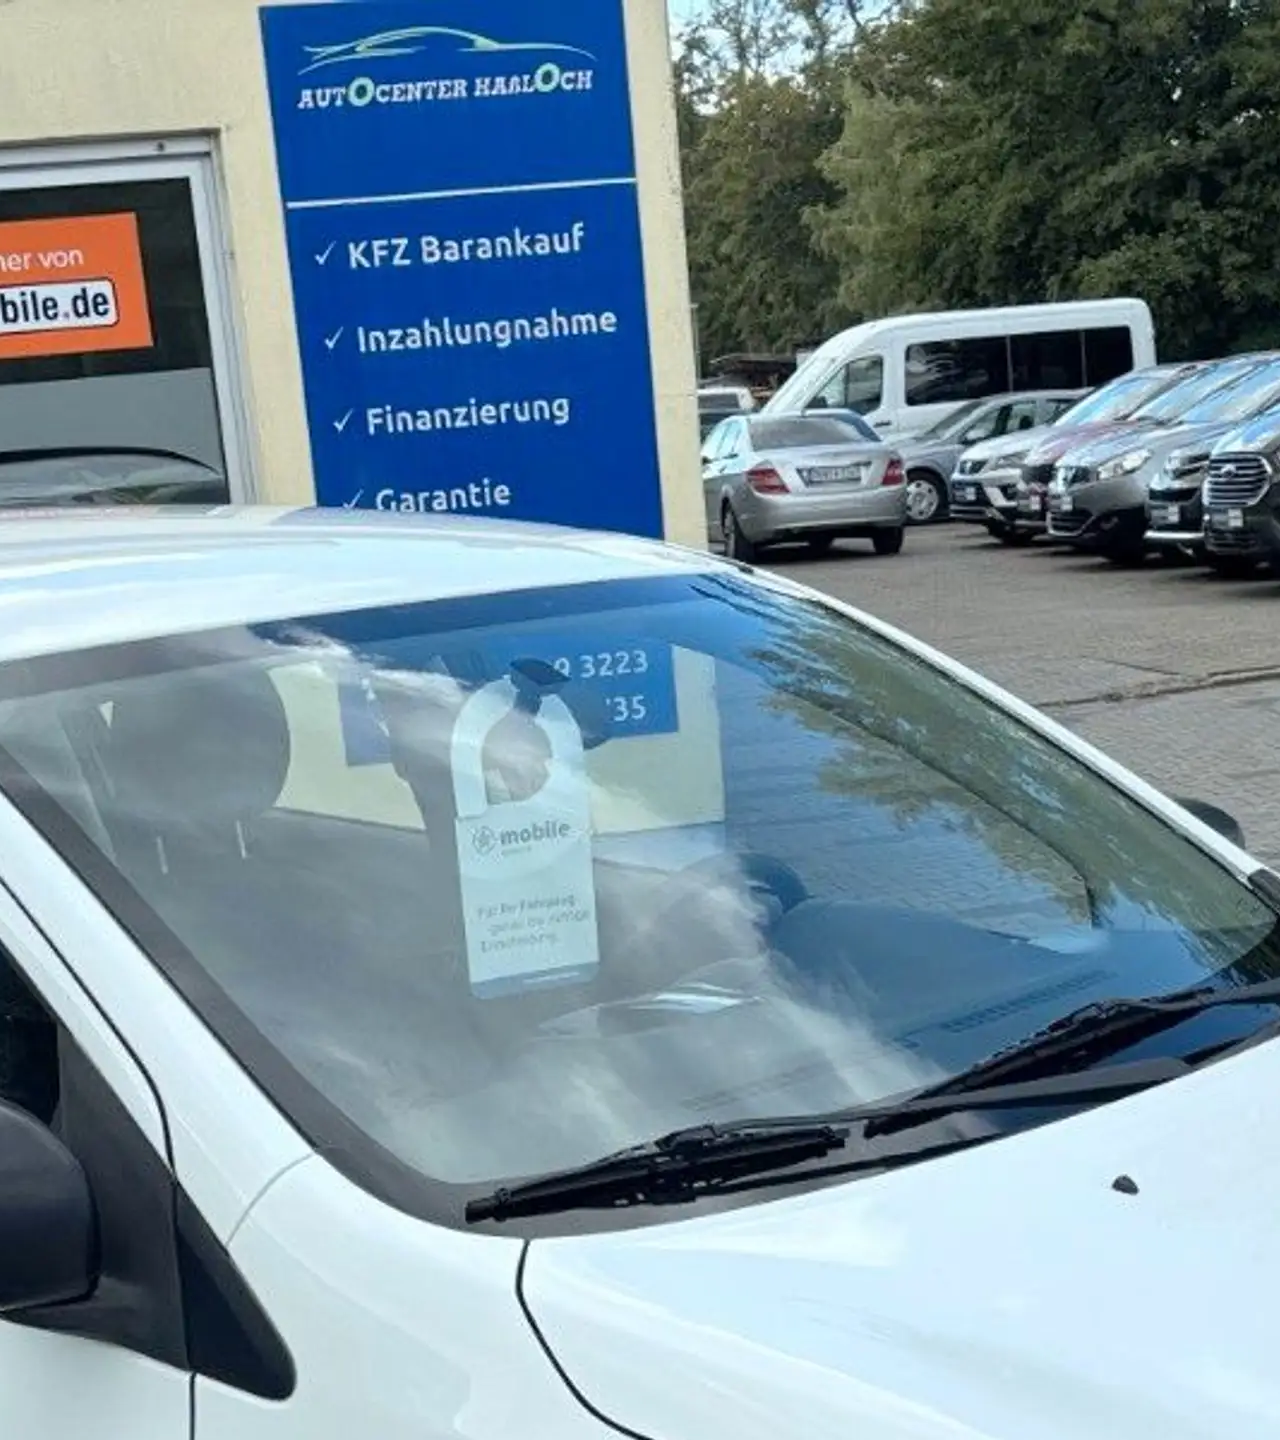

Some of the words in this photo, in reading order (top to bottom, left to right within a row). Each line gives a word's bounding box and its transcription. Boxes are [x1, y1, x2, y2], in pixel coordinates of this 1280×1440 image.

[297, 76, 468, 109] AUTOCENTER
[40, 247, 85, 270] von
[348, 237, 412, 269] KFZ
[421, 223, 585, 264] Barankauf
[357, 308, 618, 353] Inzahlungnahme
[366, 394, 571, 436] Finanzierung
[375, 478, 512, 512] Garantie
[579, 649, 649, 679] 3223
[499, 819, 572, 846] mobile
